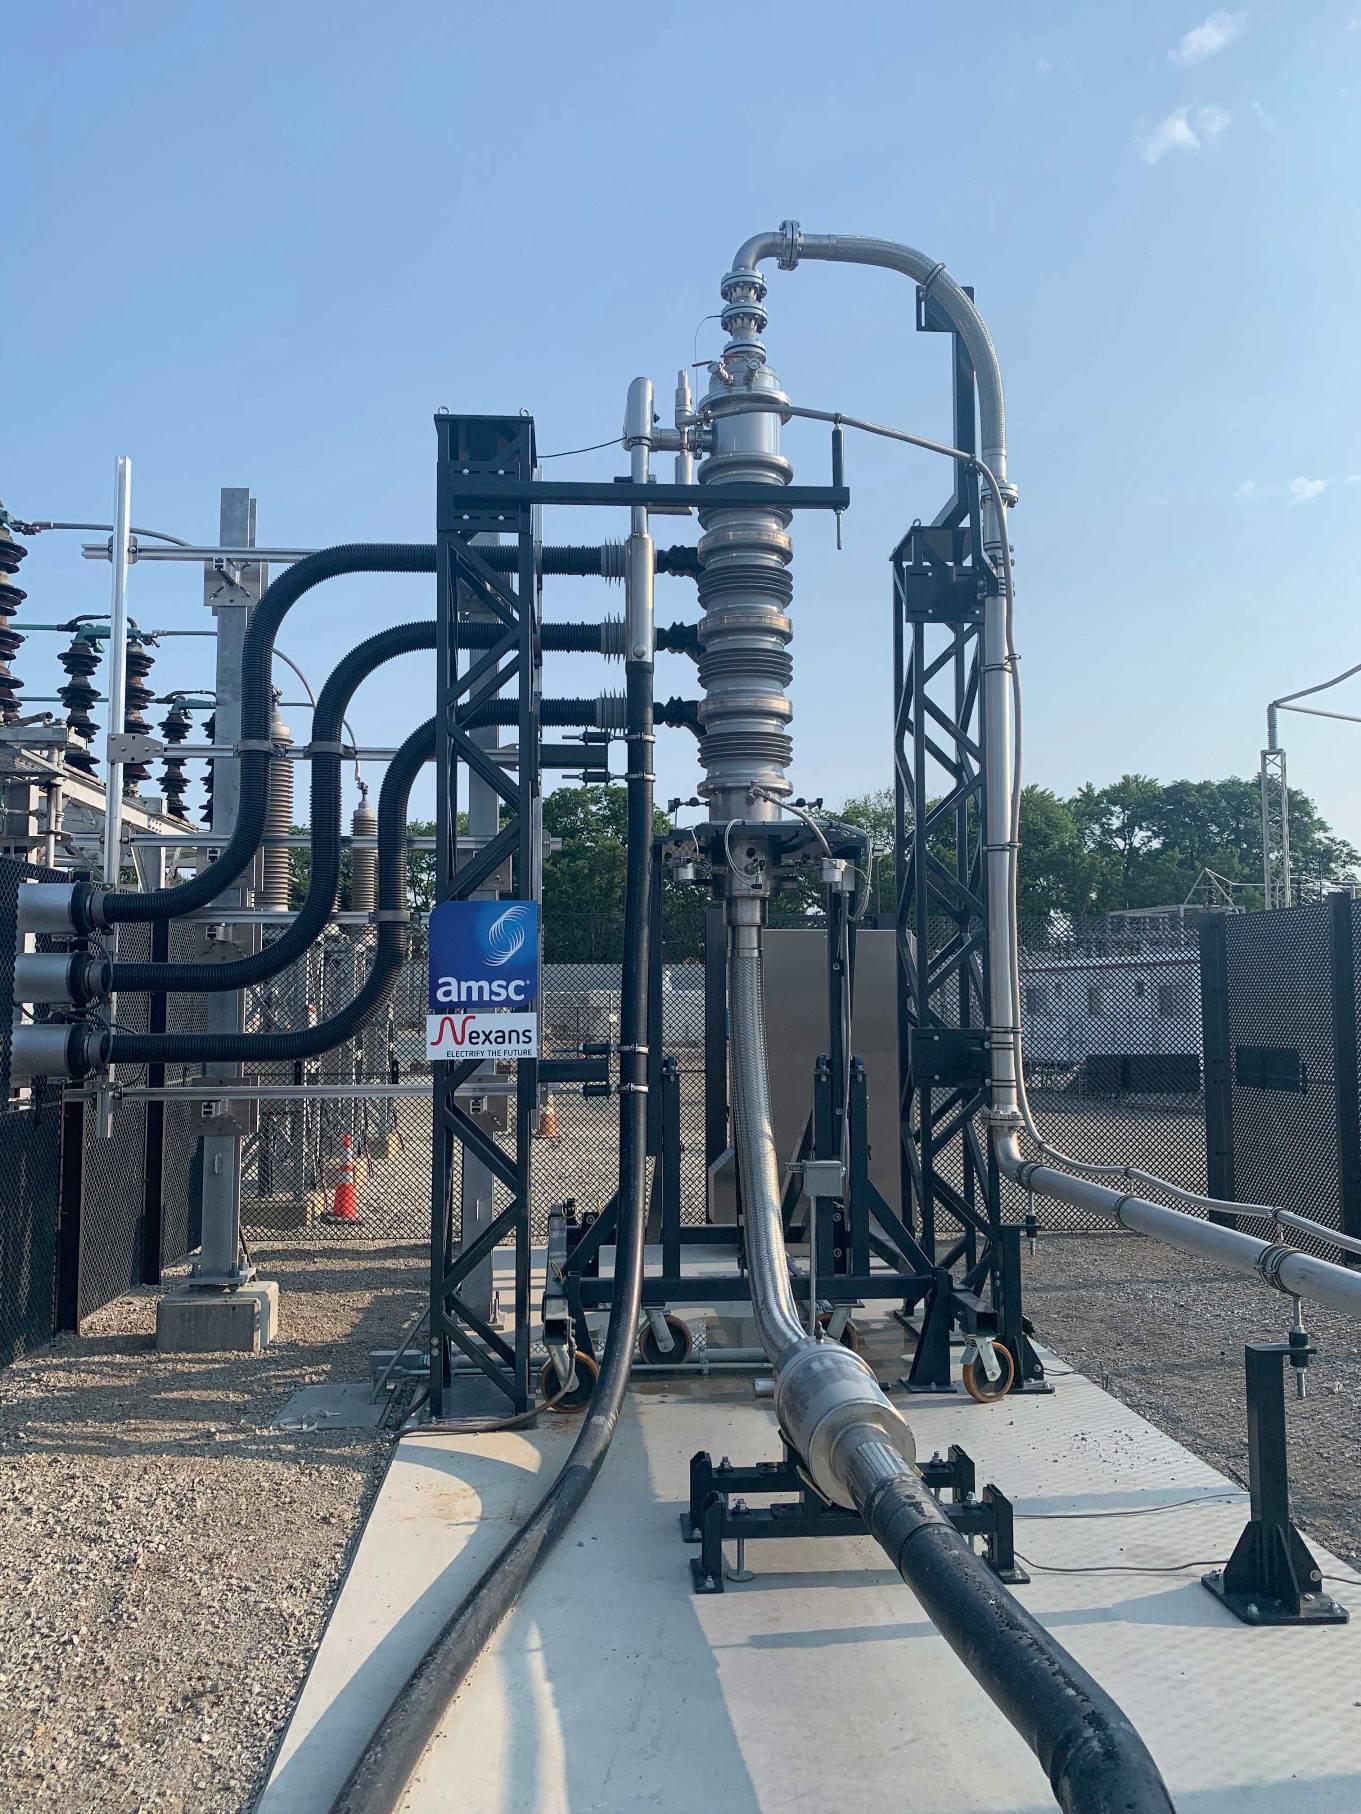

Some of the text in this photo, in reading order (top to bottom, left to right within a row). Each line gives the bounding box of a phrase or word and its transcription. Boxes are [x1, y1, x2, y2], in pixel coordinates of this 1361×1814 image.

[436, 976, 525, 1002] amsc
[430, 1015, 533, 1046] Nexans
[446, 1049, 532, 1058] ELECTRIFY THE FUTURE
